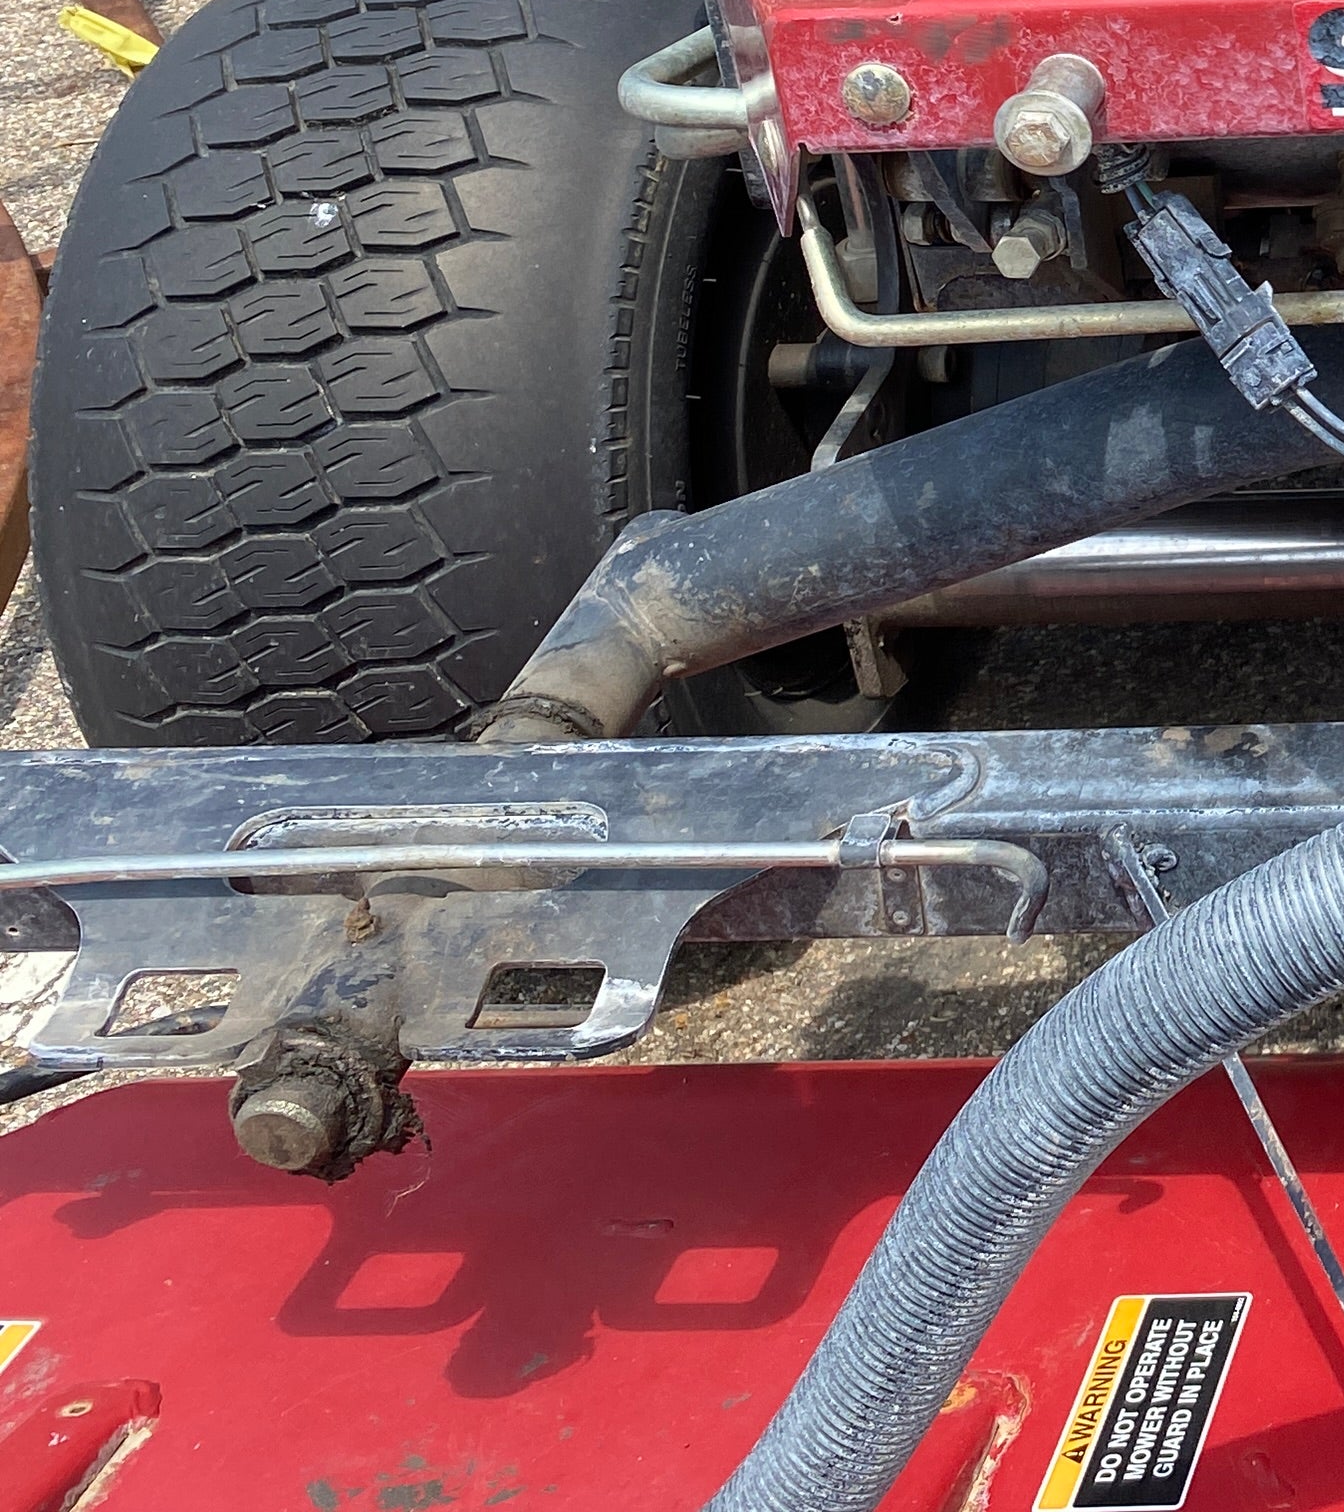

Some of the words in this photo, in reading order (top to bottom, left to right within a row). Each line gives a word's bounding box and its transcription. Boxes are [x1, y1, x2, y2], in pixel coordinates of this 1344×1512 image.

[675, 264, 697, 371] TUBELESS
[1075, 1339, 1128, 1442] WARNING
[1094, 1454, 1123, 1484] DO
[1111, 1409, 1139, 1449] NOT
[1125, 1318, 1173, 1404] OPERATE
[1123, 1406, 1167, 1480] MOWER
[1151, 1319, 1198, 1404] WITHOUT
[1179, 1384, 1201, 1404] IN
[1185, 1319, 1225, 1382] PLACE
[1153, 1409, 1193, 1478] GUARD
